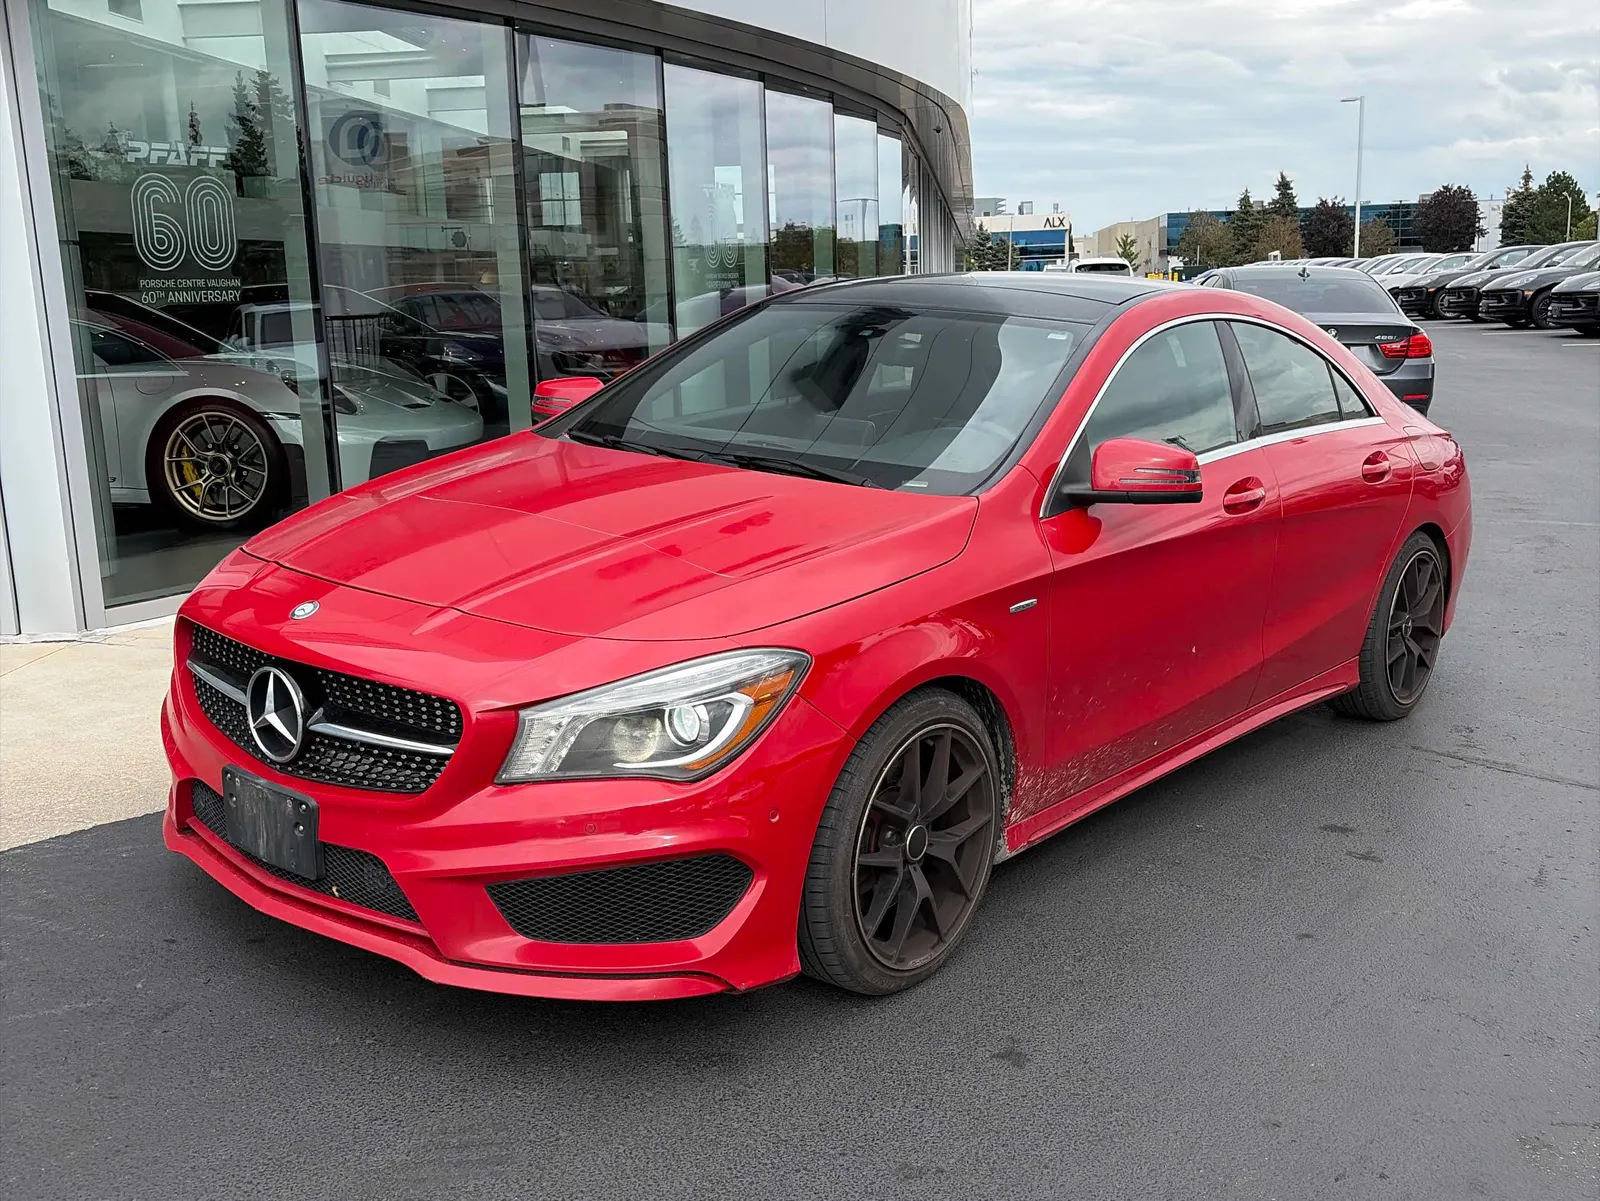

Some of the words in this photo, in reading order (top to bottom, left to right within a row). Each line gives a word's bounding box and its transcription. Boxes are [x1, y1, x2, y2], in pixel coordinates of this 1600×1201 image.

[127, 141, 228, 168] PFAFF
[131, 173, 237, 271] 60
[1043, 216, 1066, 228] ALX
[140, 279, 177, 289] PORSCHE
[177, 279, 206, 288] CENTRE
[206, 278, 241, 288] VAUGHAN
[141, 290, 166, 304] 60TH
[167, 290, 241, 303] ANNIVERSARY
